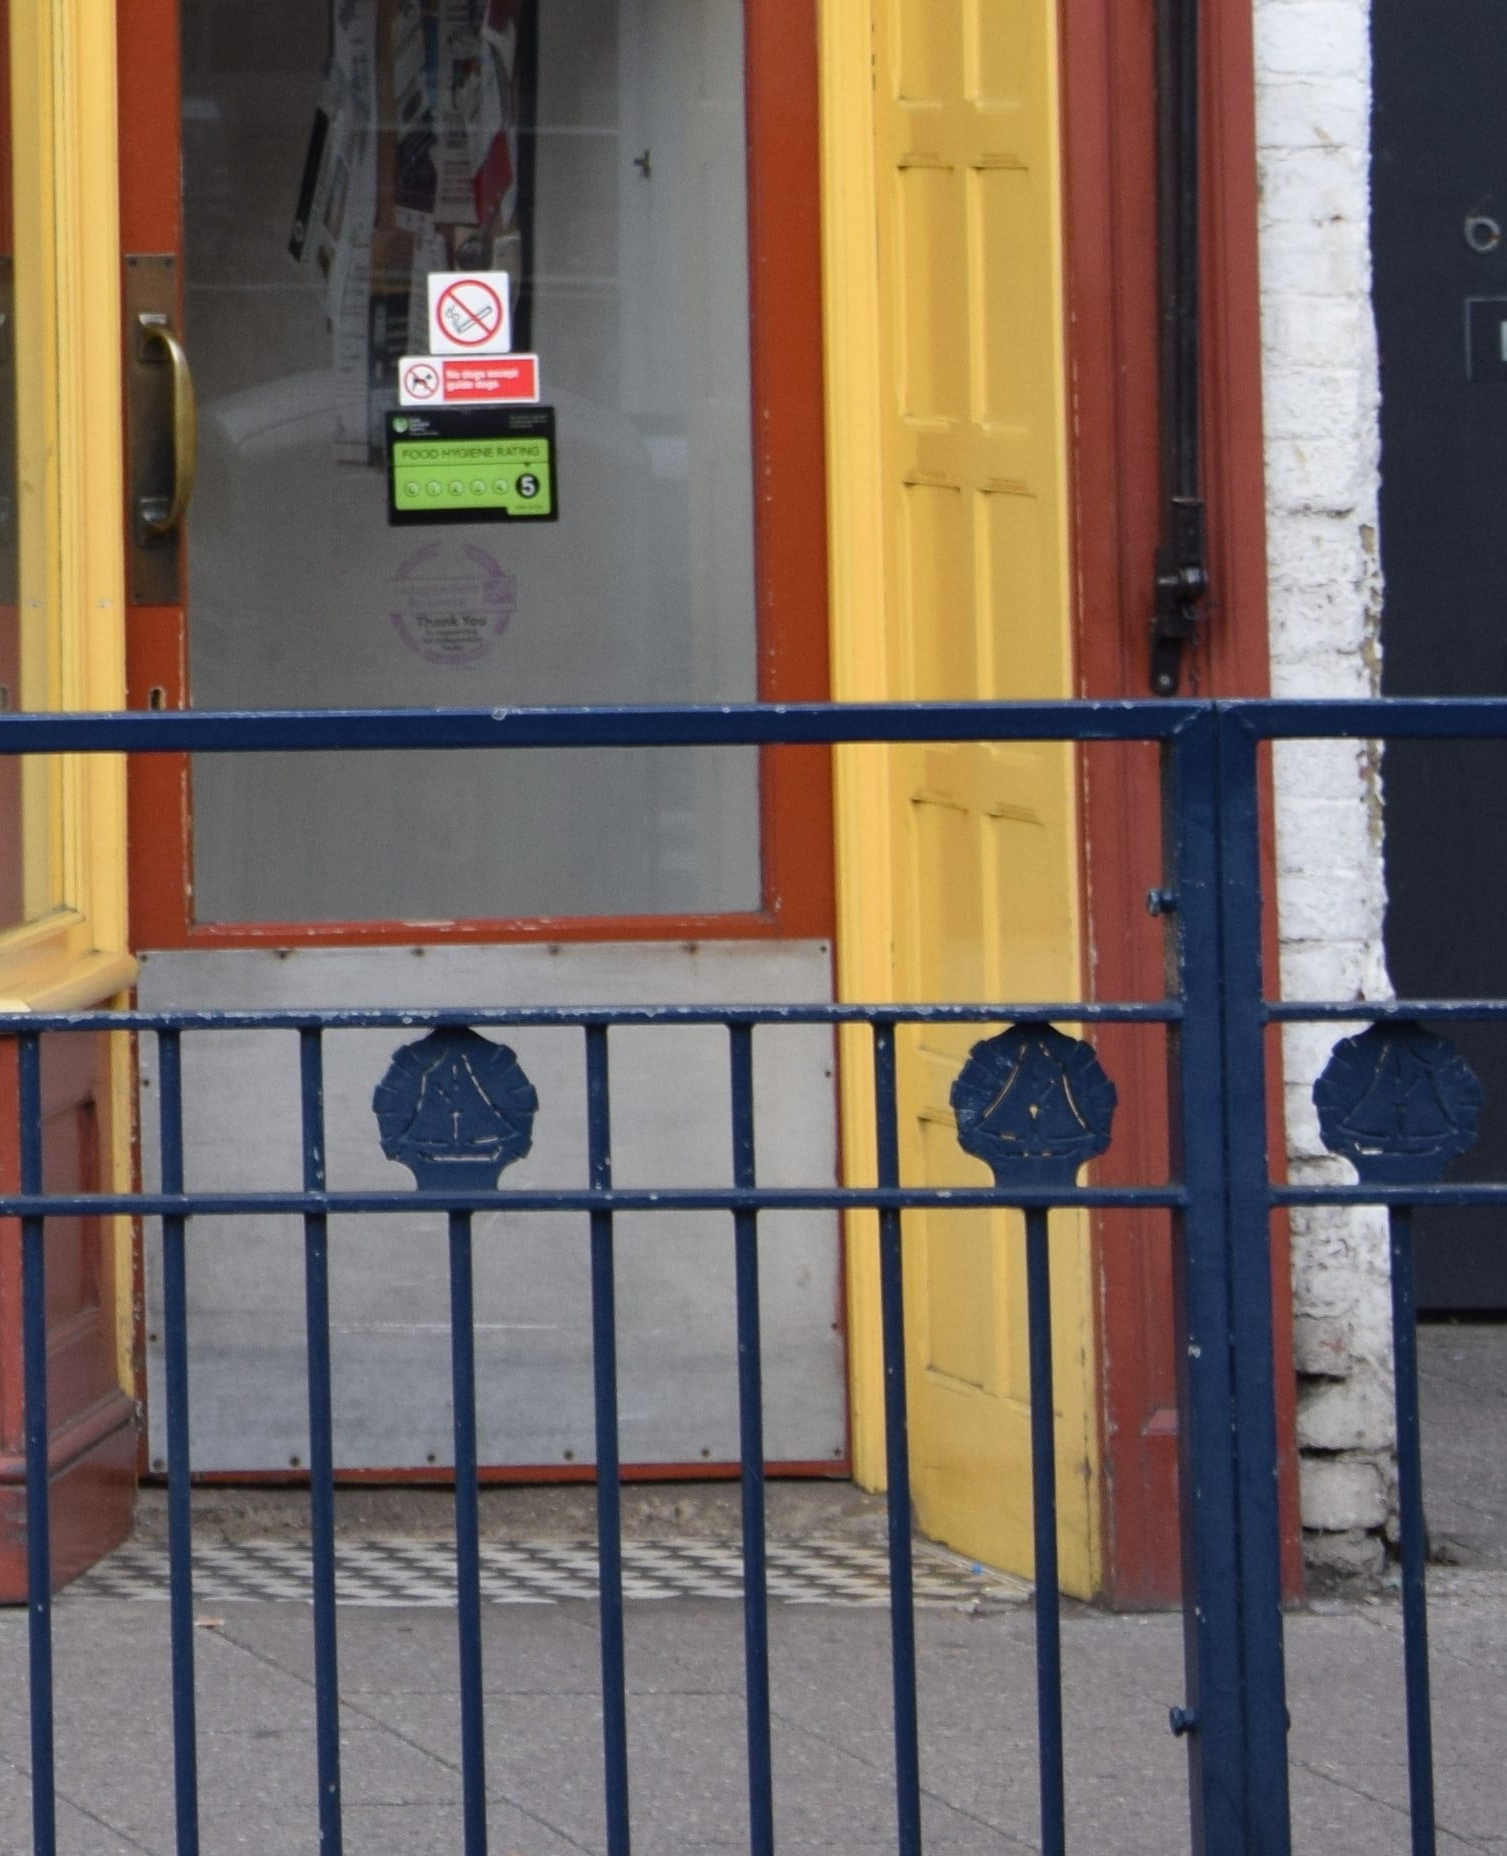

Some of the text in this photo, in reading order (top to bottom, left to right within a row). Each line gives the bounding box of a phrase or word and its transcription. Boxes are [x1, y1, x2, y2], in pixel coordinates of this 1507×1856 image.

[402, 445, 541, 460] FOOD HYGIENE RATING
[519, 475, 537, 497] 5
